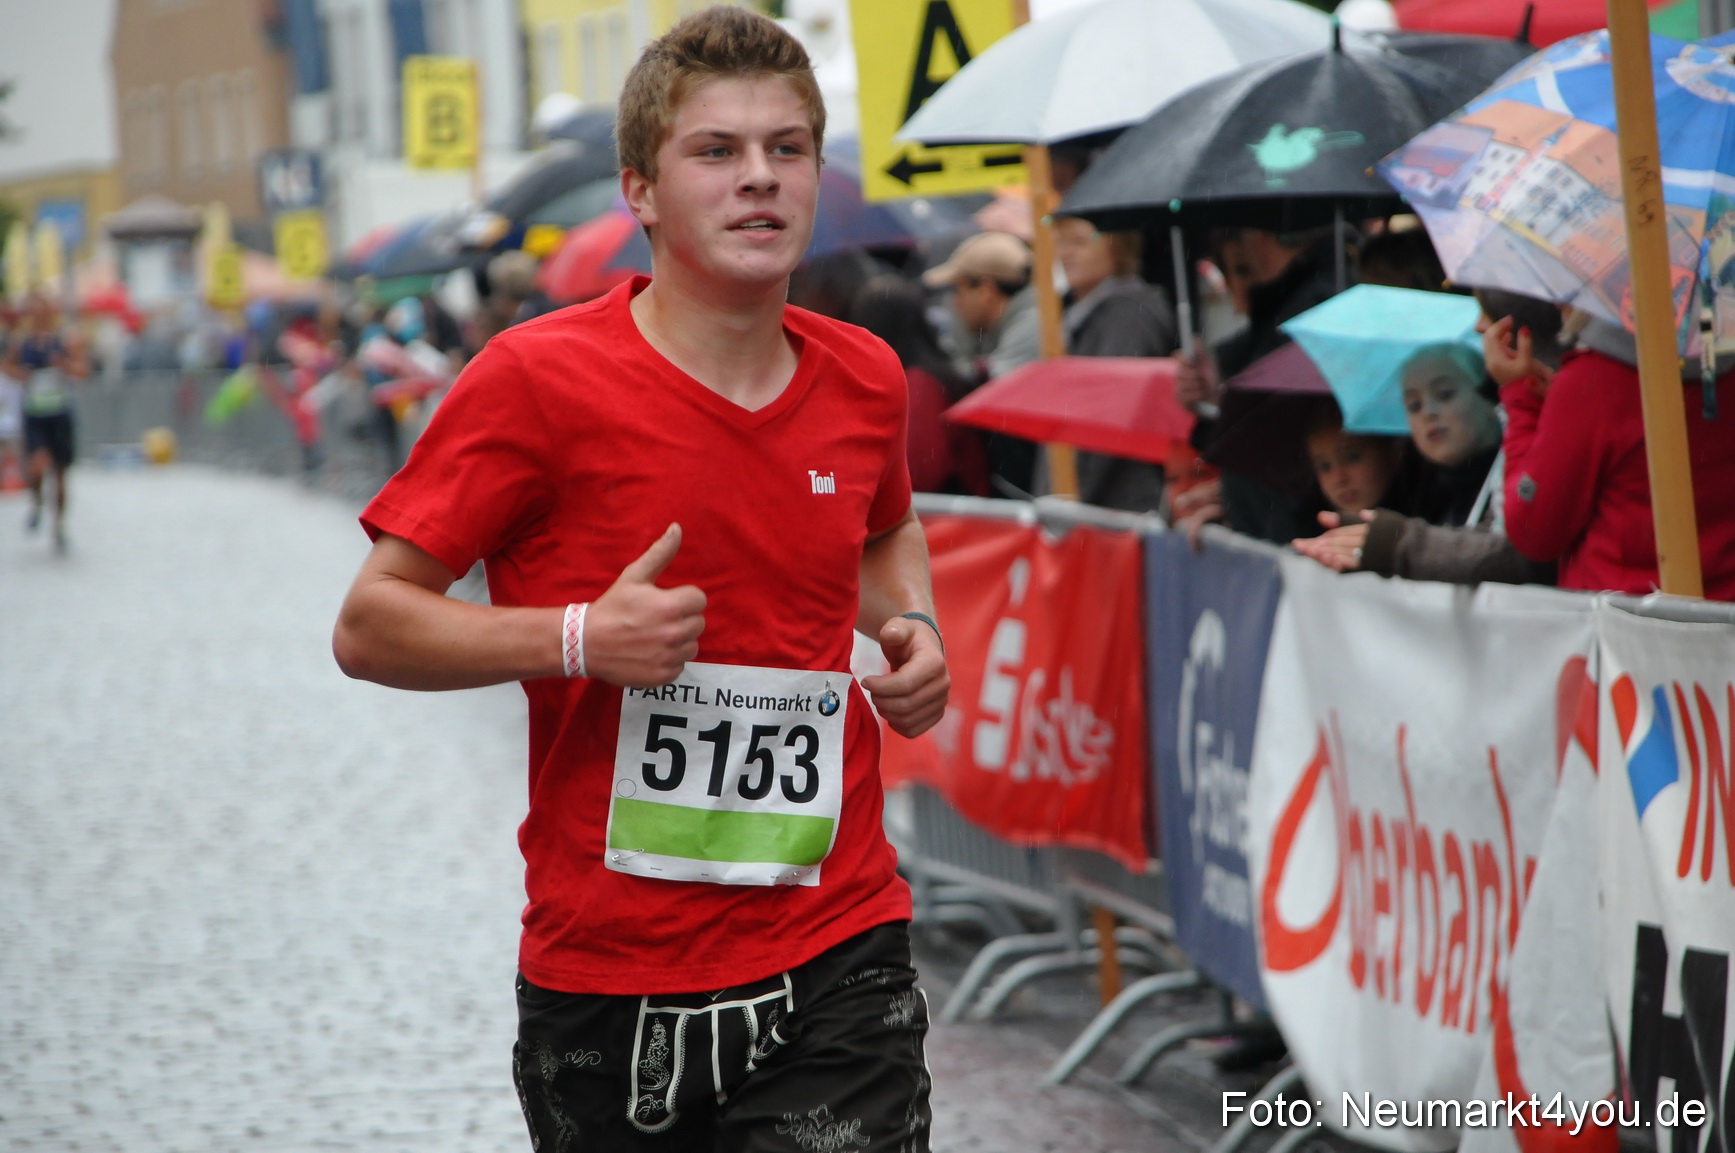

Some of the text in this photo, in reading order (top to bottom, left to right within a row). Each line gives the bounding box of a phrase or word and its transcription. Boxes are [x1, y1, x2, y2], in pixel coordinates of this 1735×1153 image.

[898, 0, 975, 128] A
[808, 470, 836, 494] Toni
[715, 688, 812, 712] Neumarkt
[641, 713, 820, 804] 5153
